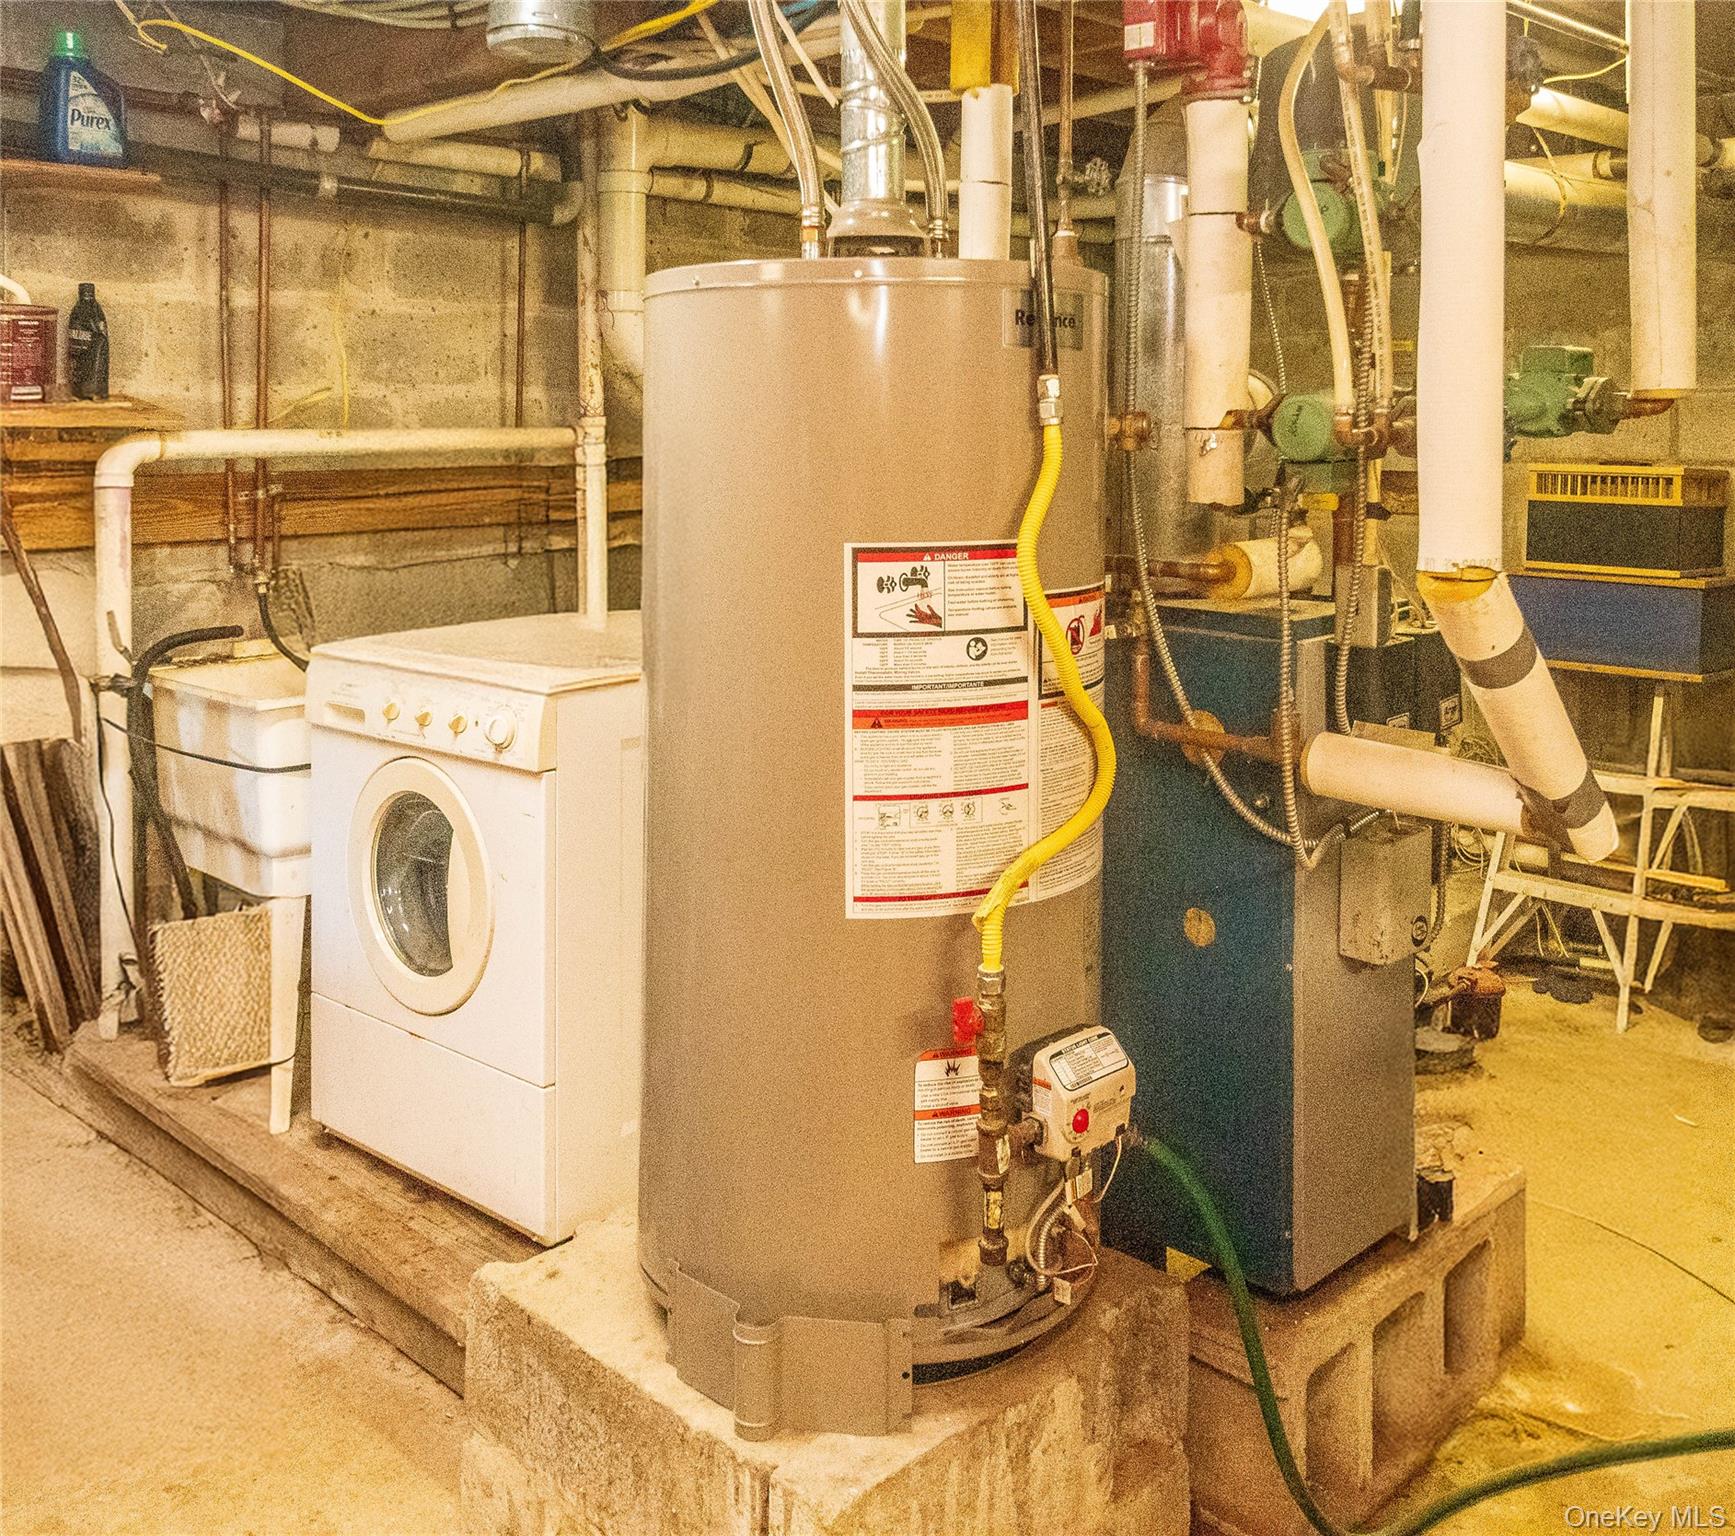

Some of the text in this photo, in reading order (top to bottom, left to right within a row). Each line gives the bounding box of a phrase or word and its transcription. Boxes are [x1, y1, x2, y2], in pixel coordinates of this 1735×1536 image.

[71, 108, 111, 130] Purex
[1015, 309, 1075, 328] Rence
[934, 552, 969, 561] DANGER
